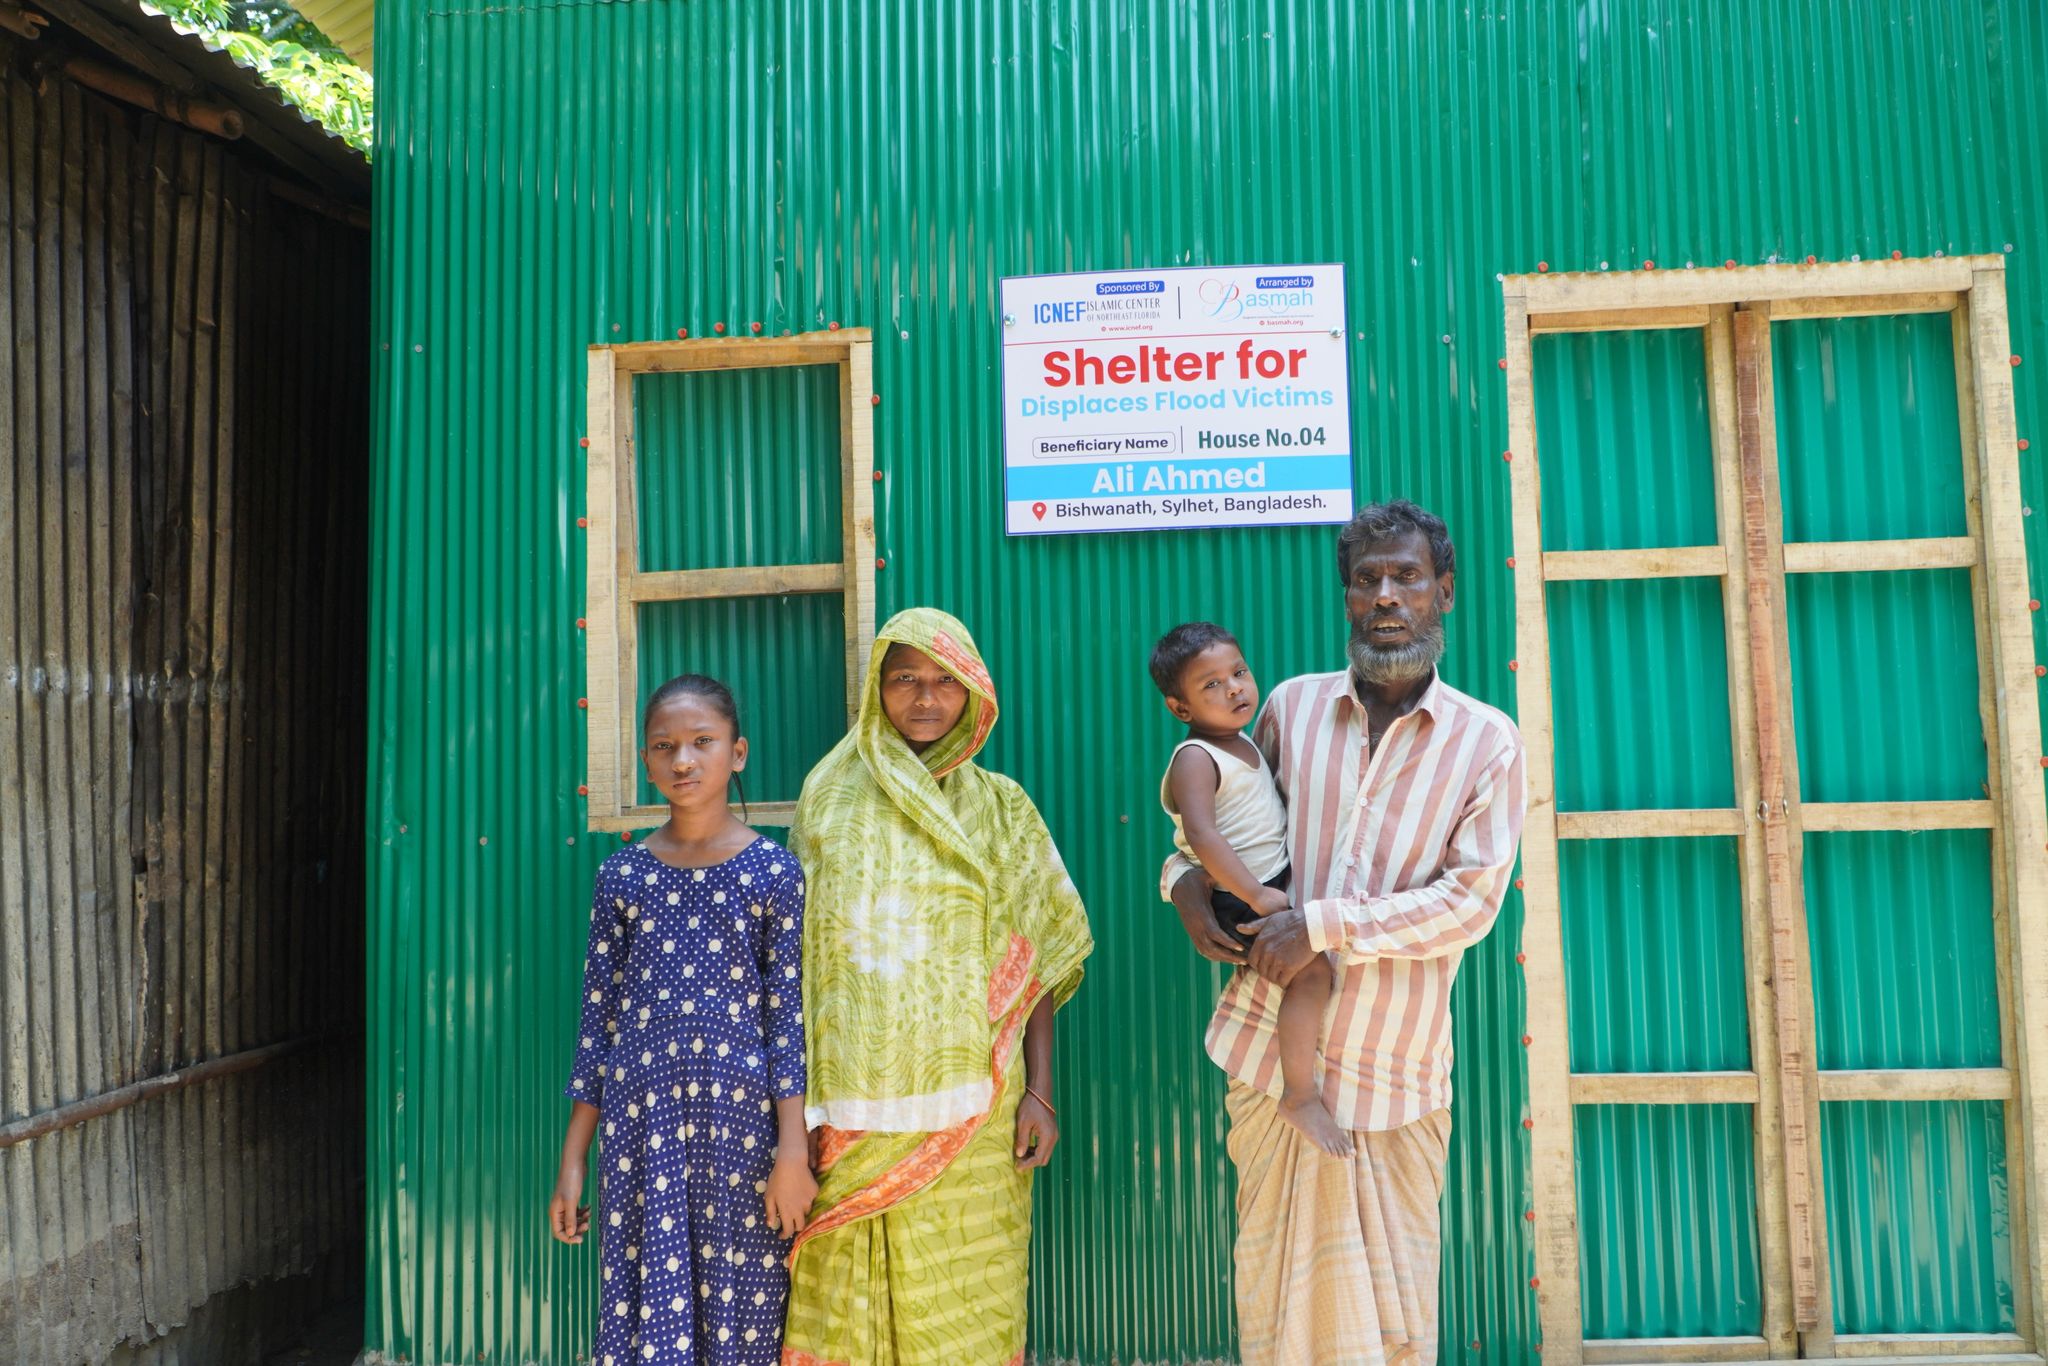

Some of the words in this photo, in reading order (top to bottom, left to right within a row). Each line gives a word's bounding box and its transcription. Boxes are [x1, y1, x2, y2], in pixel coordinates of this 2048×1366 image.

[1099, 282, 1147, 294] Sponsored
[1148, 281, 1160, 292] By
[1258, 277, 1299, 288] Arranged
[1301, 276, 1313, 288] by
[1034, 301, 1086, 324] ICNEF
[1086, 299, 1123, 311] ISLAMIC
[1125, 297, 1161, 310] CENTER
[1096, 313, 1132, 322] NORTHEAST
[1134, 312, 1161, 320] FLORIDA
[1043, 345, 1225, 388] Shelter
[1236, 339, 1307, 380] for
[1021, 394, 1148, 422] Displaces
[1155, 389, 1226, 411] Flood
[1232, 385, 1334, 409] Victims
[1040, 438, 1122, 454] Beneficiary
[1125, 438, 1169, 450] Name
[1198, 430, 1260, 449] House
[1266, 426, 1326, 447] No.04
[1091, 463, 1135, 494] Ali
[1142, 461, 1266, 492] Ahmed
[1056, 500, 1157, 518] Bishwanath,
[1162, 497, 1219, 516] Sylhet,
[1224, 494, 1327, 514] Bangladesh.
